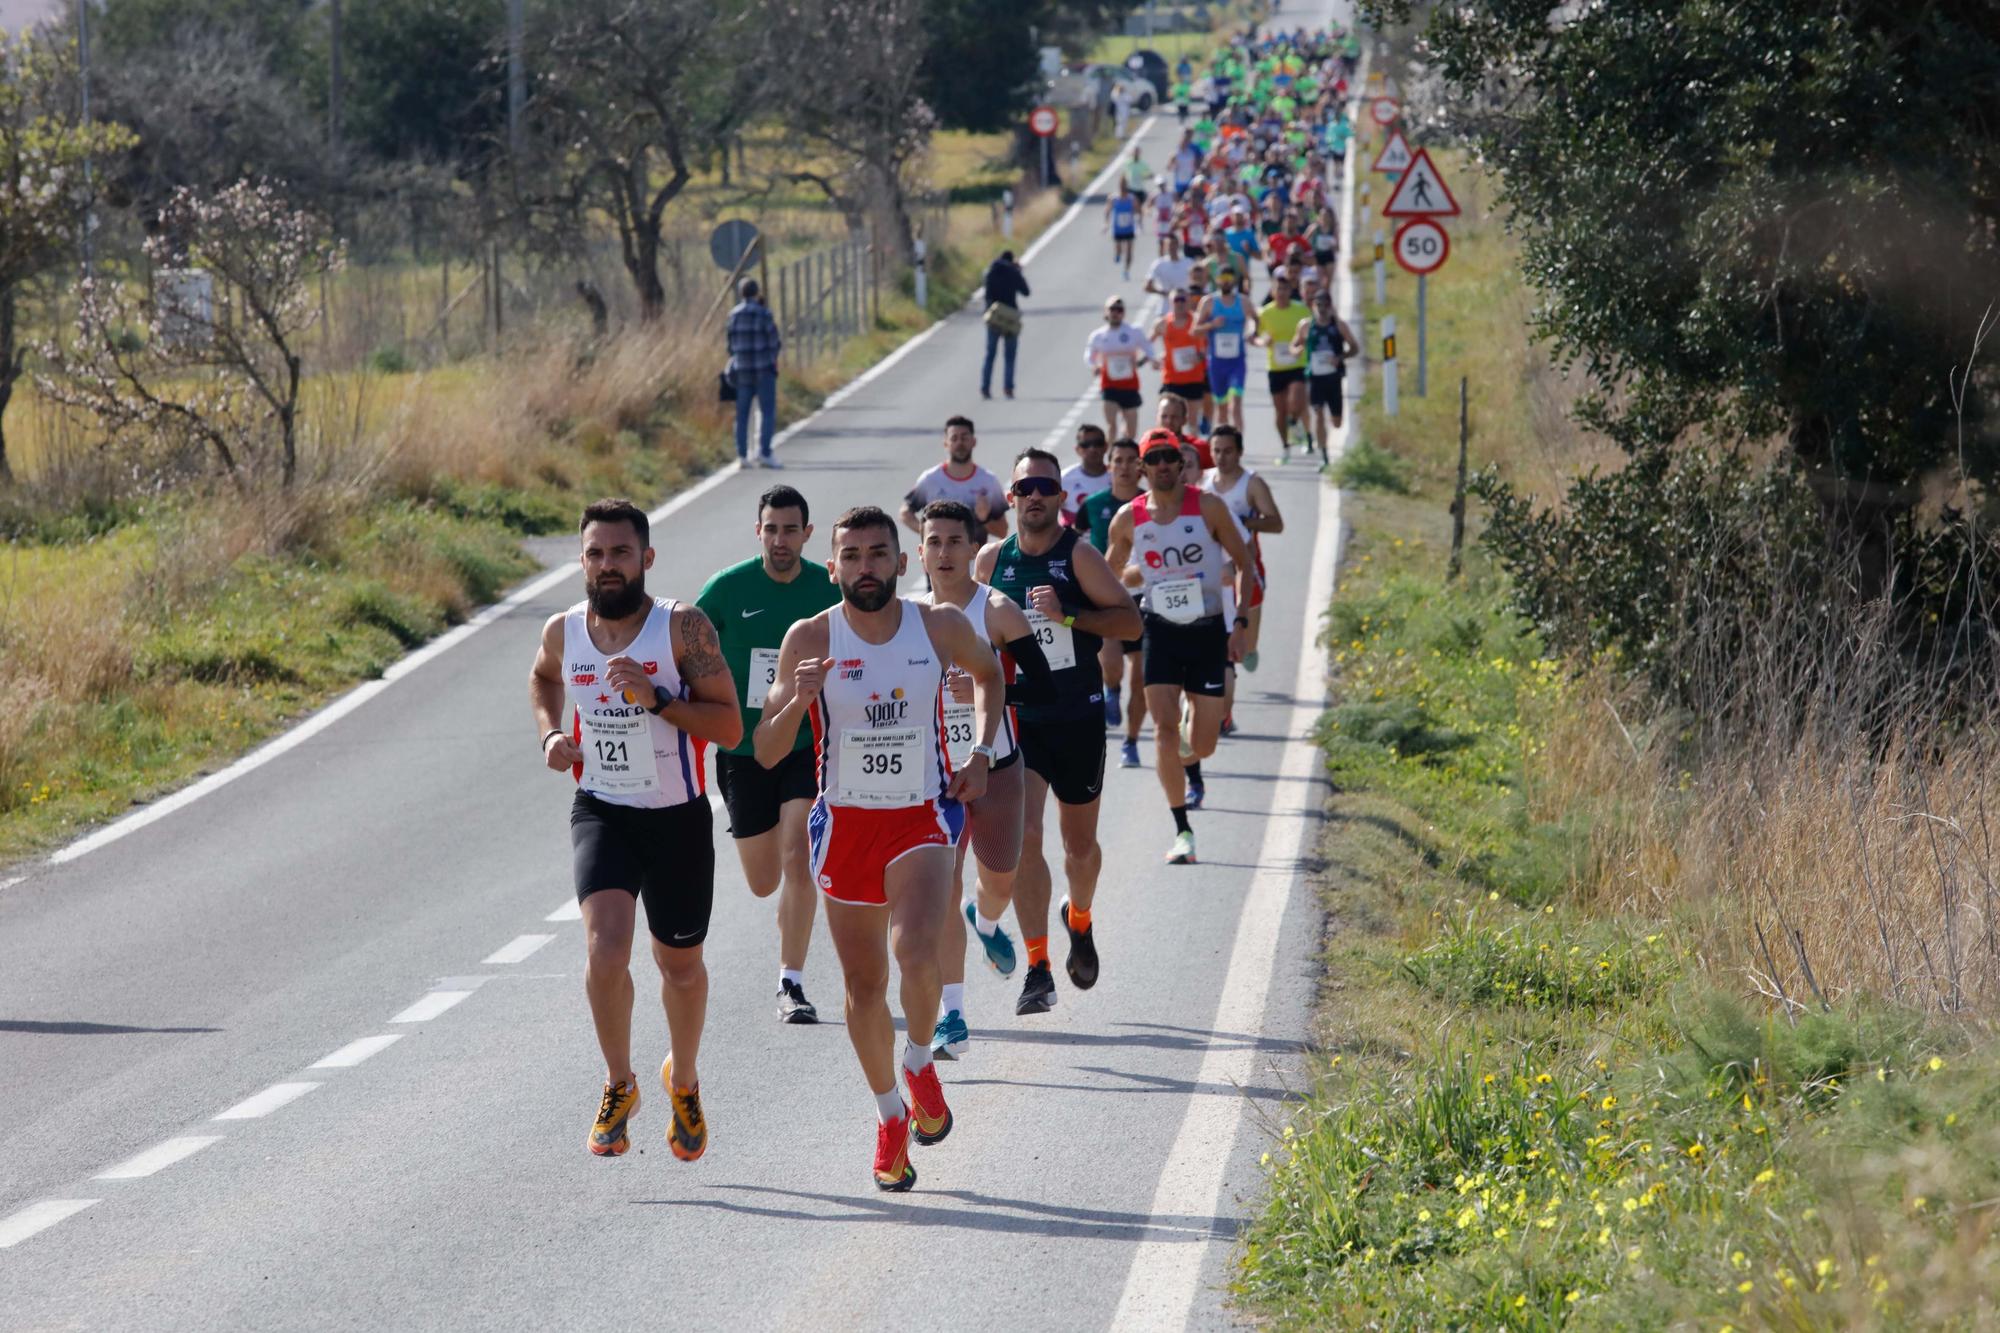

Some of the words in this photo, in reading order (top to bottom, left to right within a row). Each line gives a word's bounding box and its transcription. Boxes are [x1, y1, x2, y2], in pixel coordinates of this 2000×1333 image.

[1407, 236, 1437, 256] 50
[1165, 595, 1189, 609] 354
[1035, 627, 1054, 645] 43
[571, 663, 596, 673] U-run
[864, 700, 908, 729] space
[595, 740, 628, 762] 121
[862, 753, 903, 775] 395
